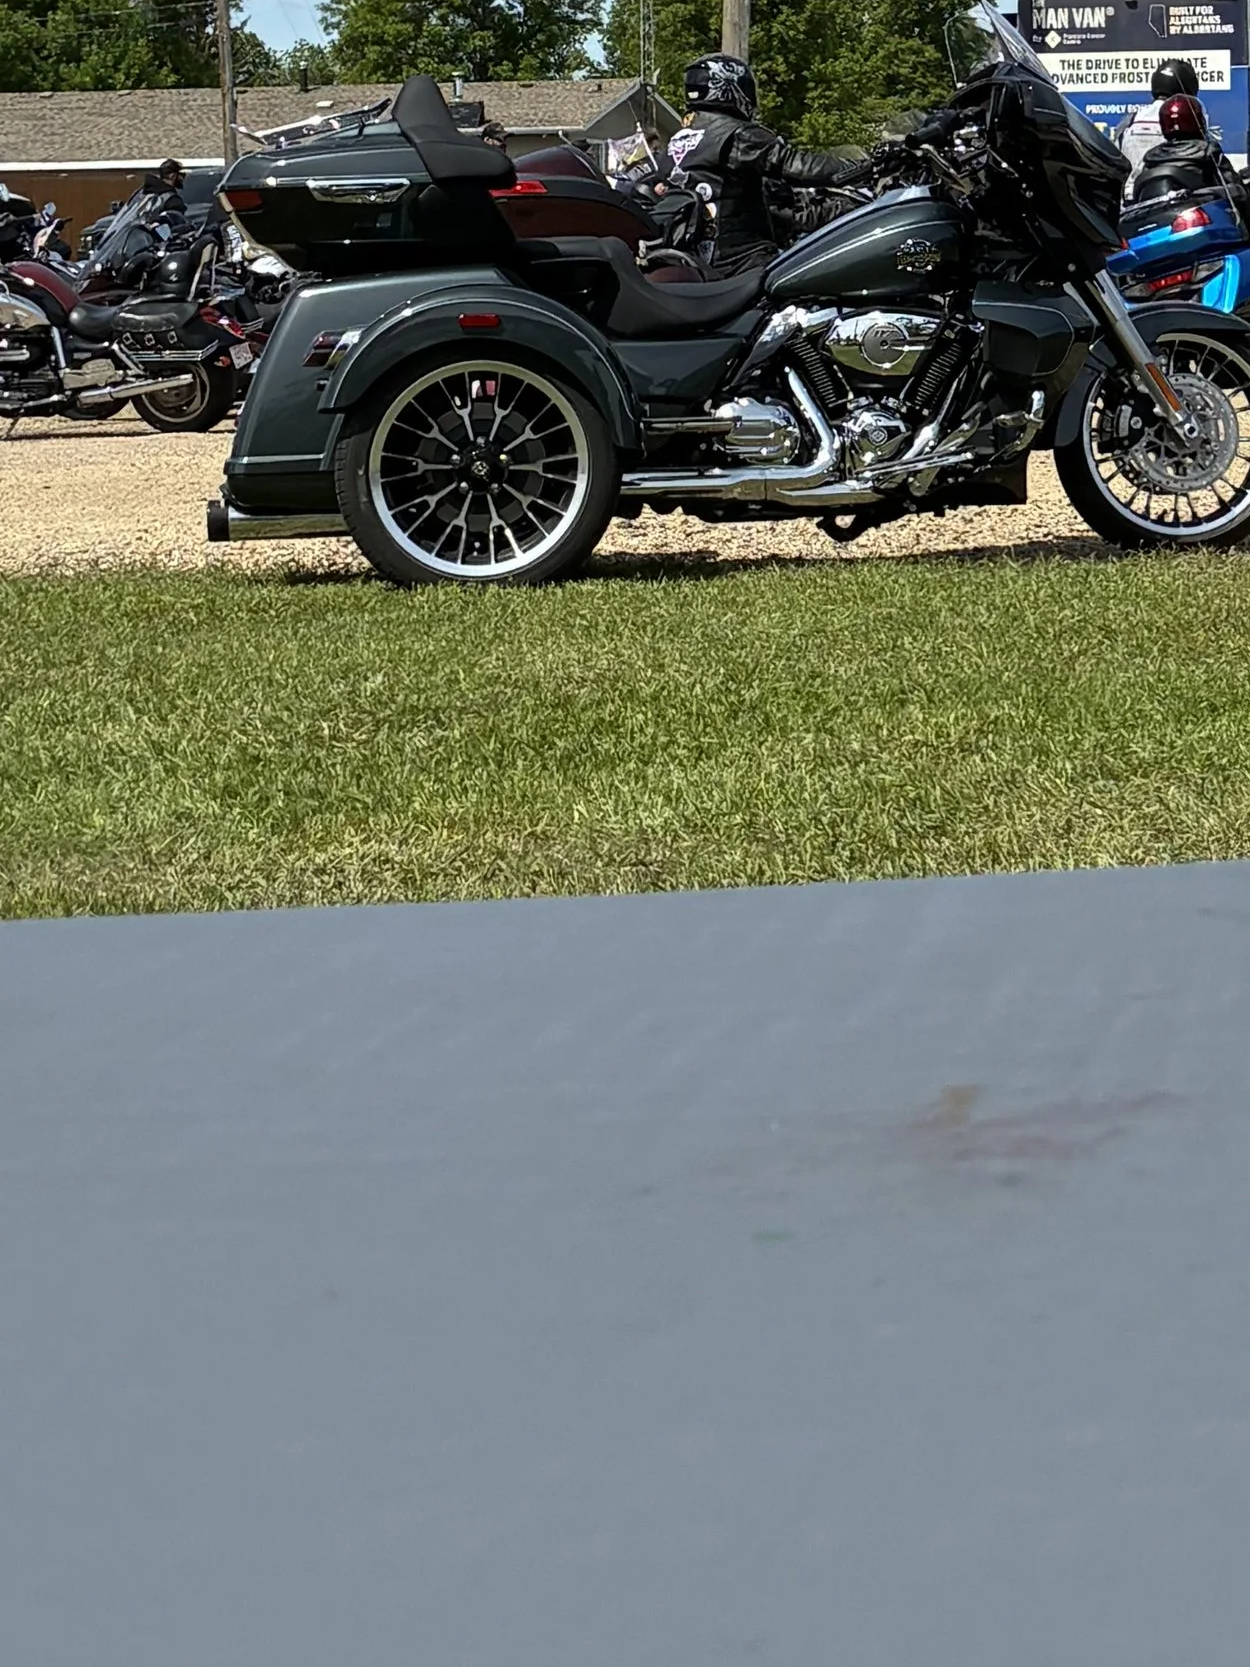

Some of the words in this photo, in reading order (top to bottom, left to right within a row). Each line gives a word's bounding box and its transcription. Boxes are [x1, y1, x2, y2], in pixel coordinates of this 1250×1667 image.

[1195, 5, 1214, 15] FOR
[1032, 7, 1069, 29] MAN
[1059, 59, 1083, 70] THE
[1085, 58, 1121, 70] DRIVE
[1124, 58, 1140, 69] TO
[1050, 73, 1109, 85] DVANCED
